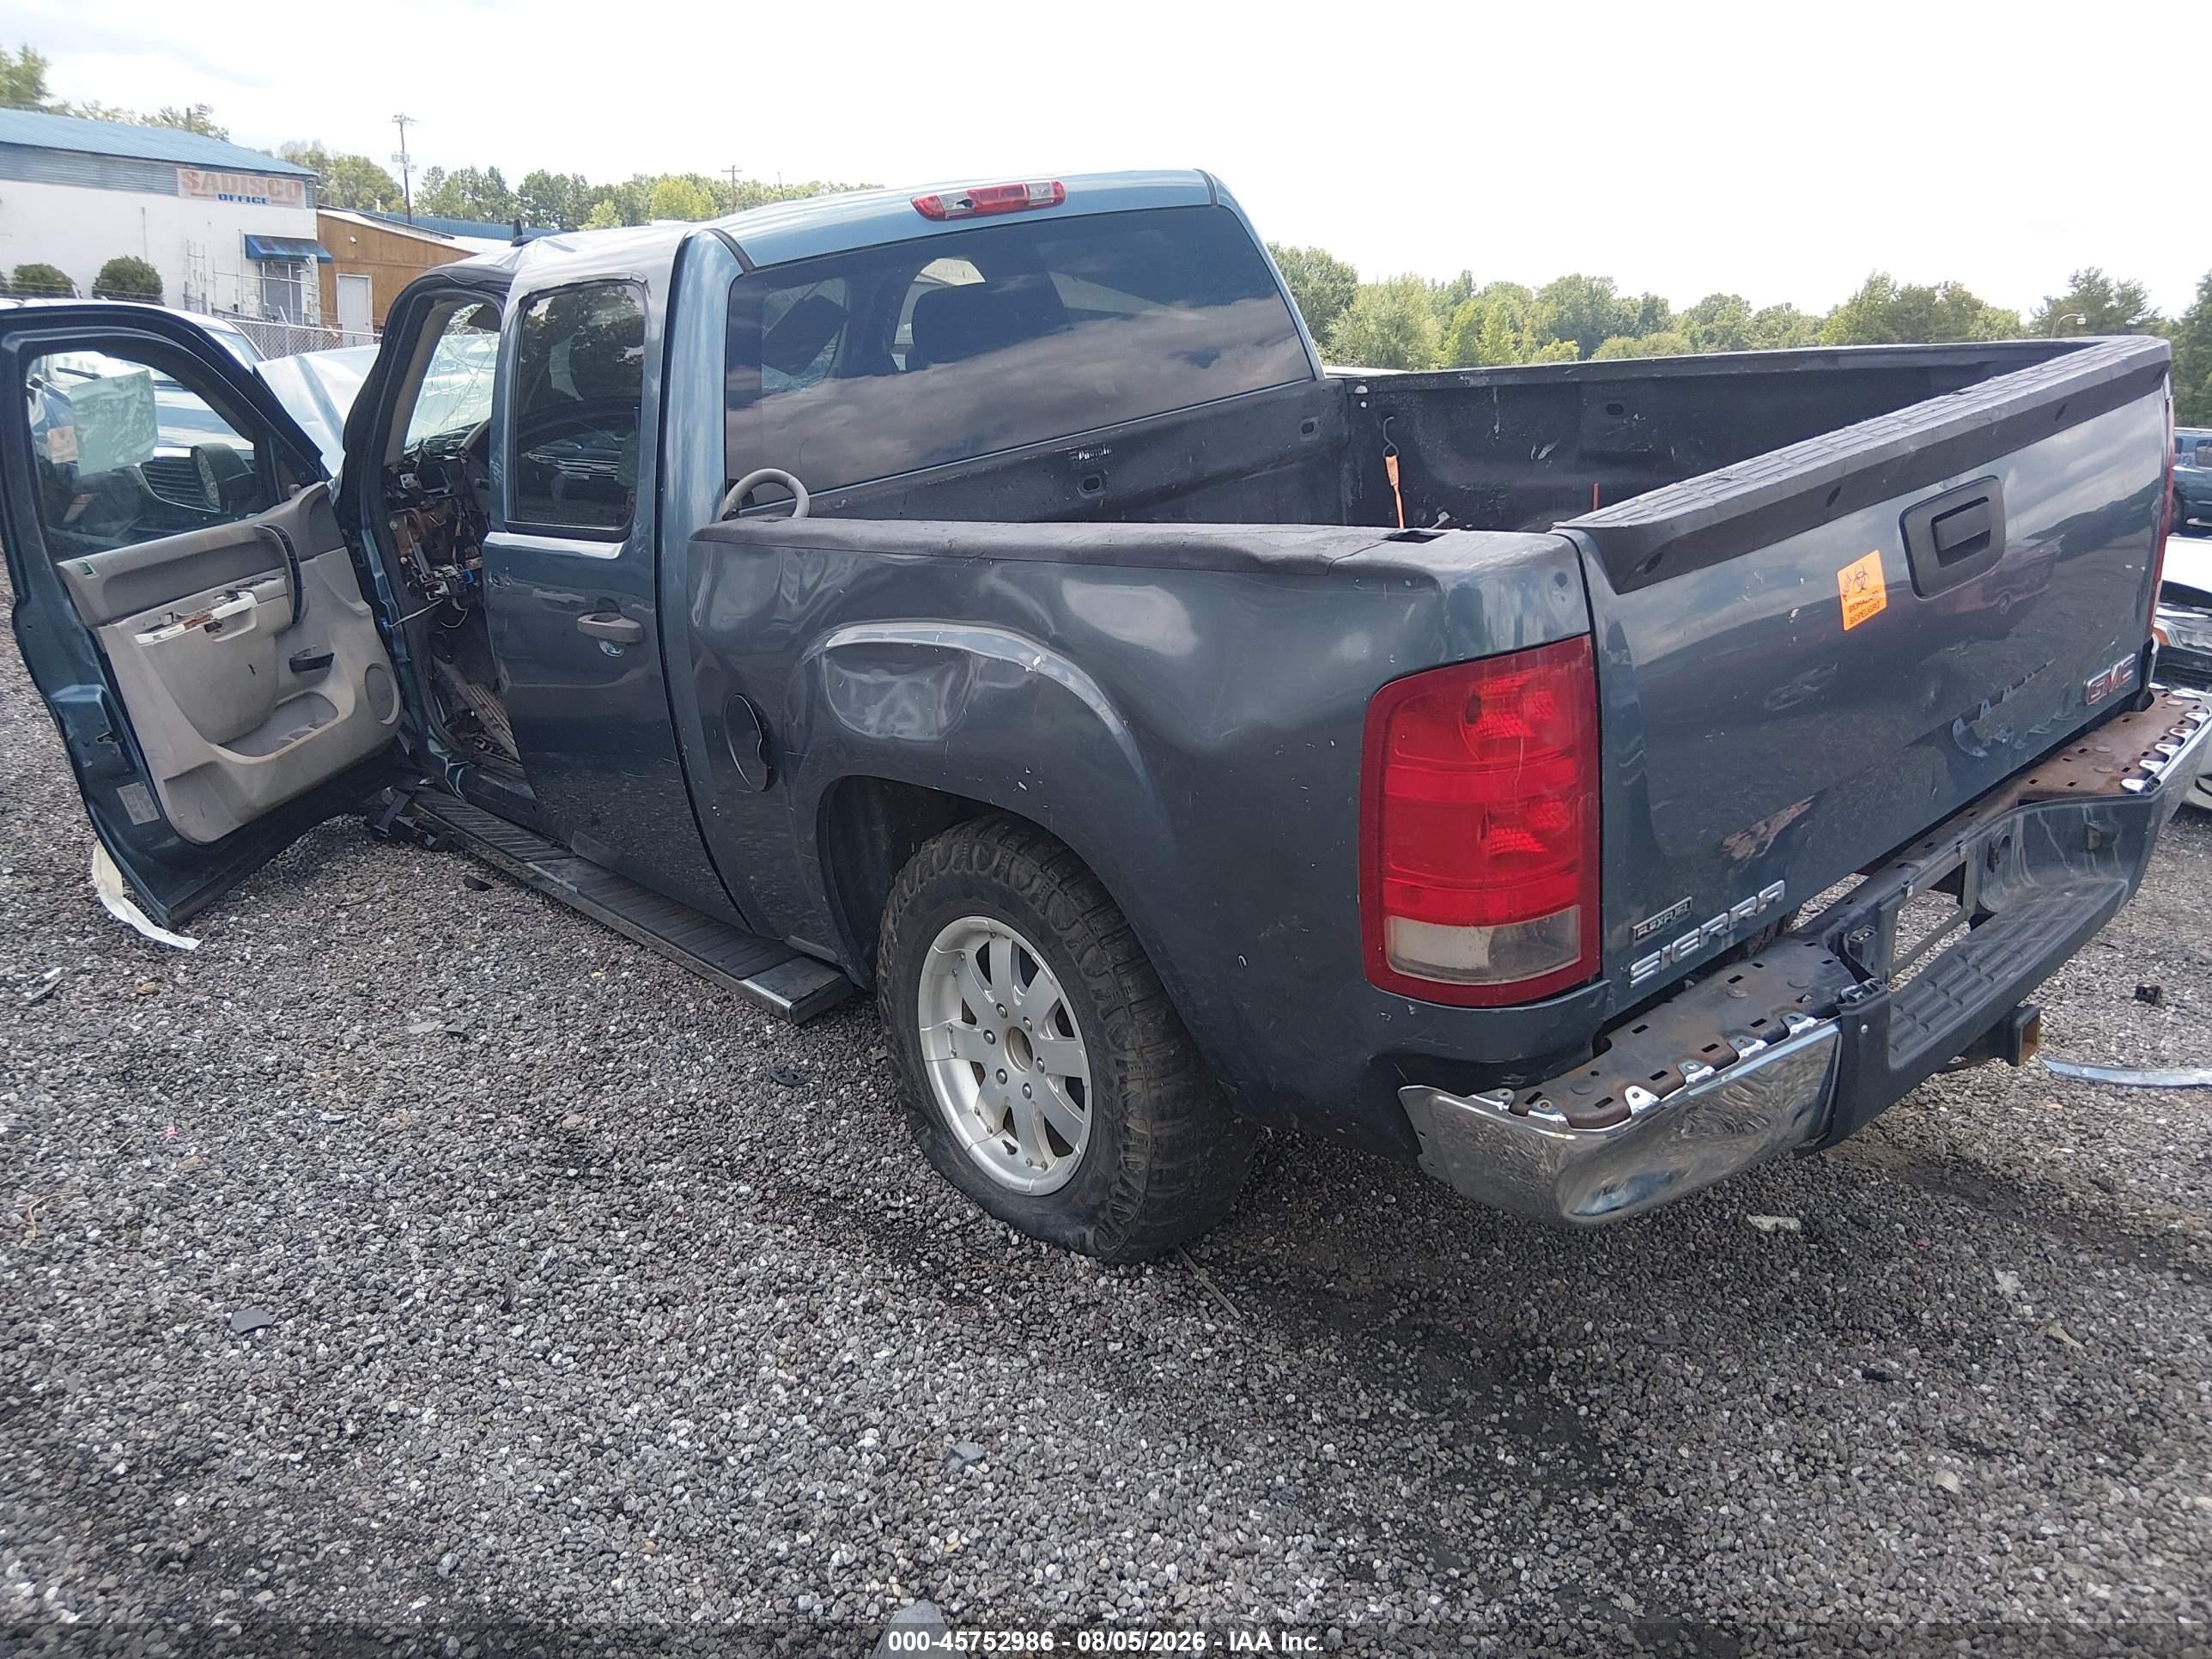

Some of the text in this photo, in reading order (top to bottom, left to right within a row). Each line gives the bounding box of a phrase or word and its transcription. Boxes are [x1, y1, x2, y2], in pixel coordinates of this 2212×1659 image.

[182, 170, 302, 198] SADISCO
[218, 193, 269, 205] OFFICE
[2084, 653, 2136, 705] GMC
[1629, 878, 1786, 989] SIERRA
[1635, 902, 1692, 939] FLEXFUEL
